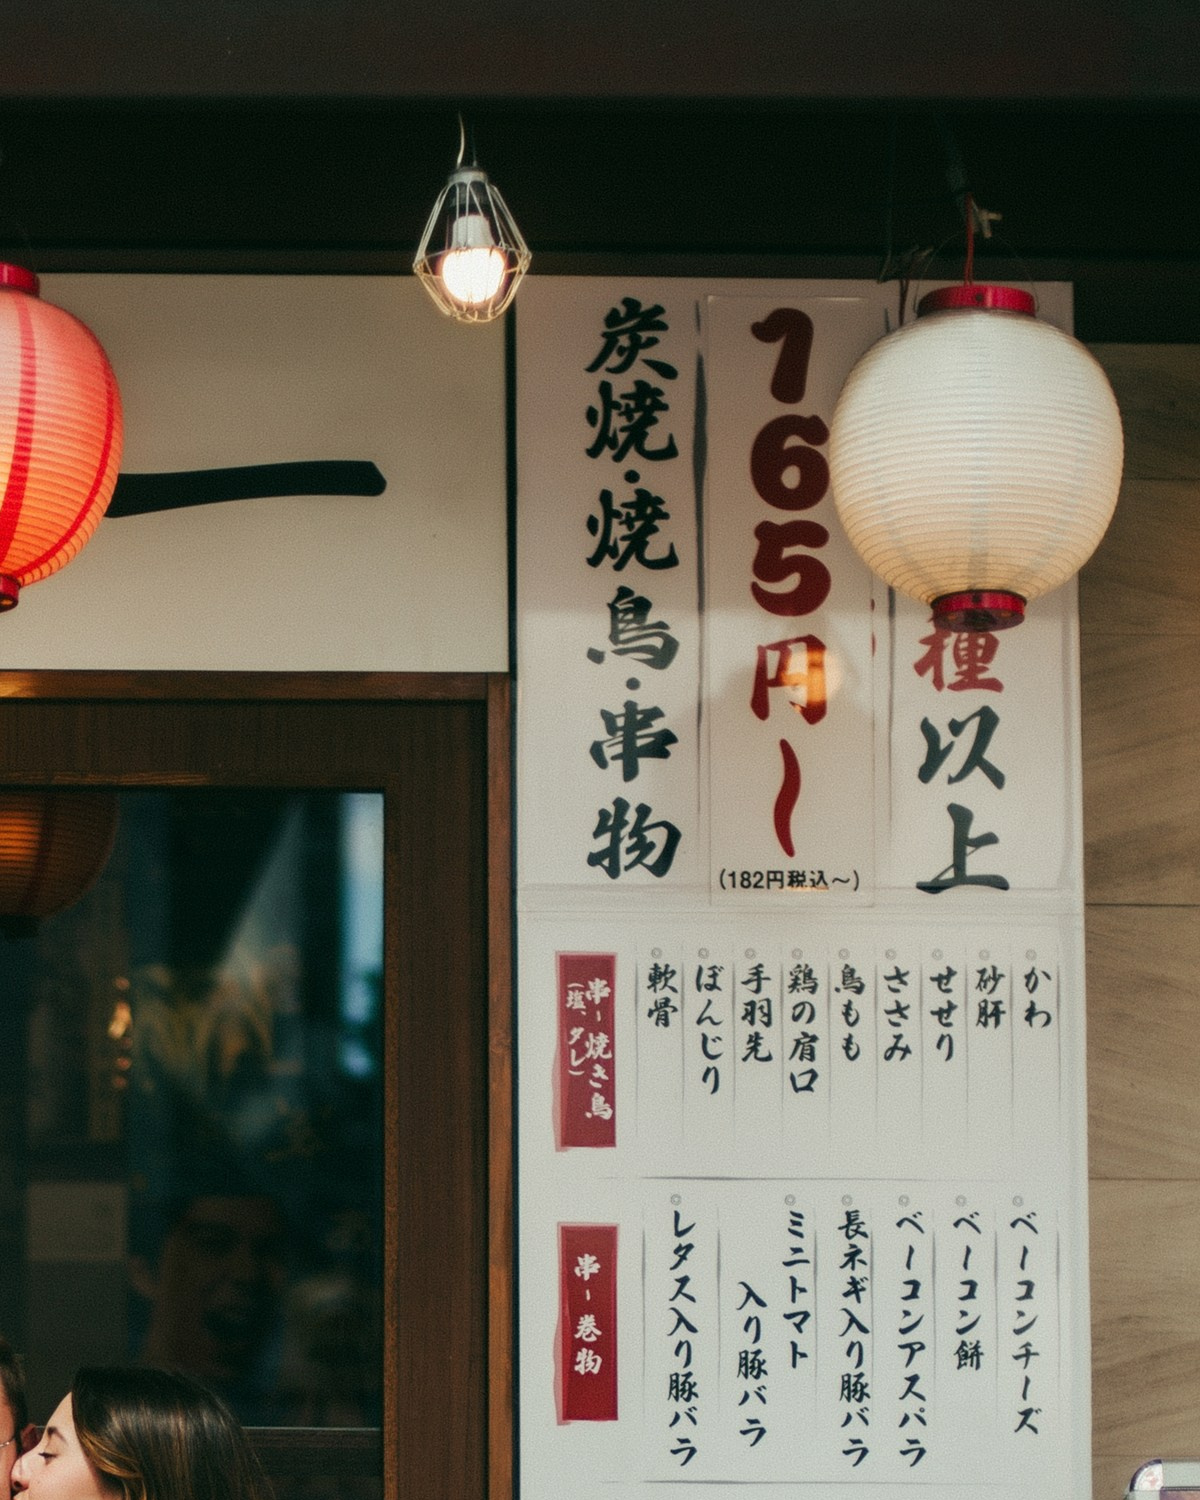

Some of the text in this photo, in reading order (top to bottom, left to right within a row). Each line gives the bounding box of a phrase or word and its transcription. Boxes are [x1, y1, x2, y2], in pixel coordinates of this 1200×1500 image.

[585, 297, 682, 880] 炭焼・焼鳥・串物
[646, 962, 679, 1028] 軟骨
[695, 964, 724, 1095] ぼんじり
[740, 963, 773, 1063] 手羽先
[834, 963, 866, 1062] 鳥もも
[883, 966, 912, 1062] ささみ
[929, 965, 958, 1062] せせり
[976, 965, 1007, 1029] 砂肝
[1023, 966, 1052, 1028] かわ
[667, 1210, 699, 1467] レタス入り豚バラ
[781, 1210, 811, 1369] ミニトマト
[837, 1209, 871, 1467] 長ネギ入り豚バラ
[895, 1211, 927, 1468] ベーコンアスパラ
[952, 1211, 984, 1371] ベーコン餅
[1009, 1211, 1042, 1435] ベーコンチーズ
[736, 1281, 769, 1448] 入り豚バラ
